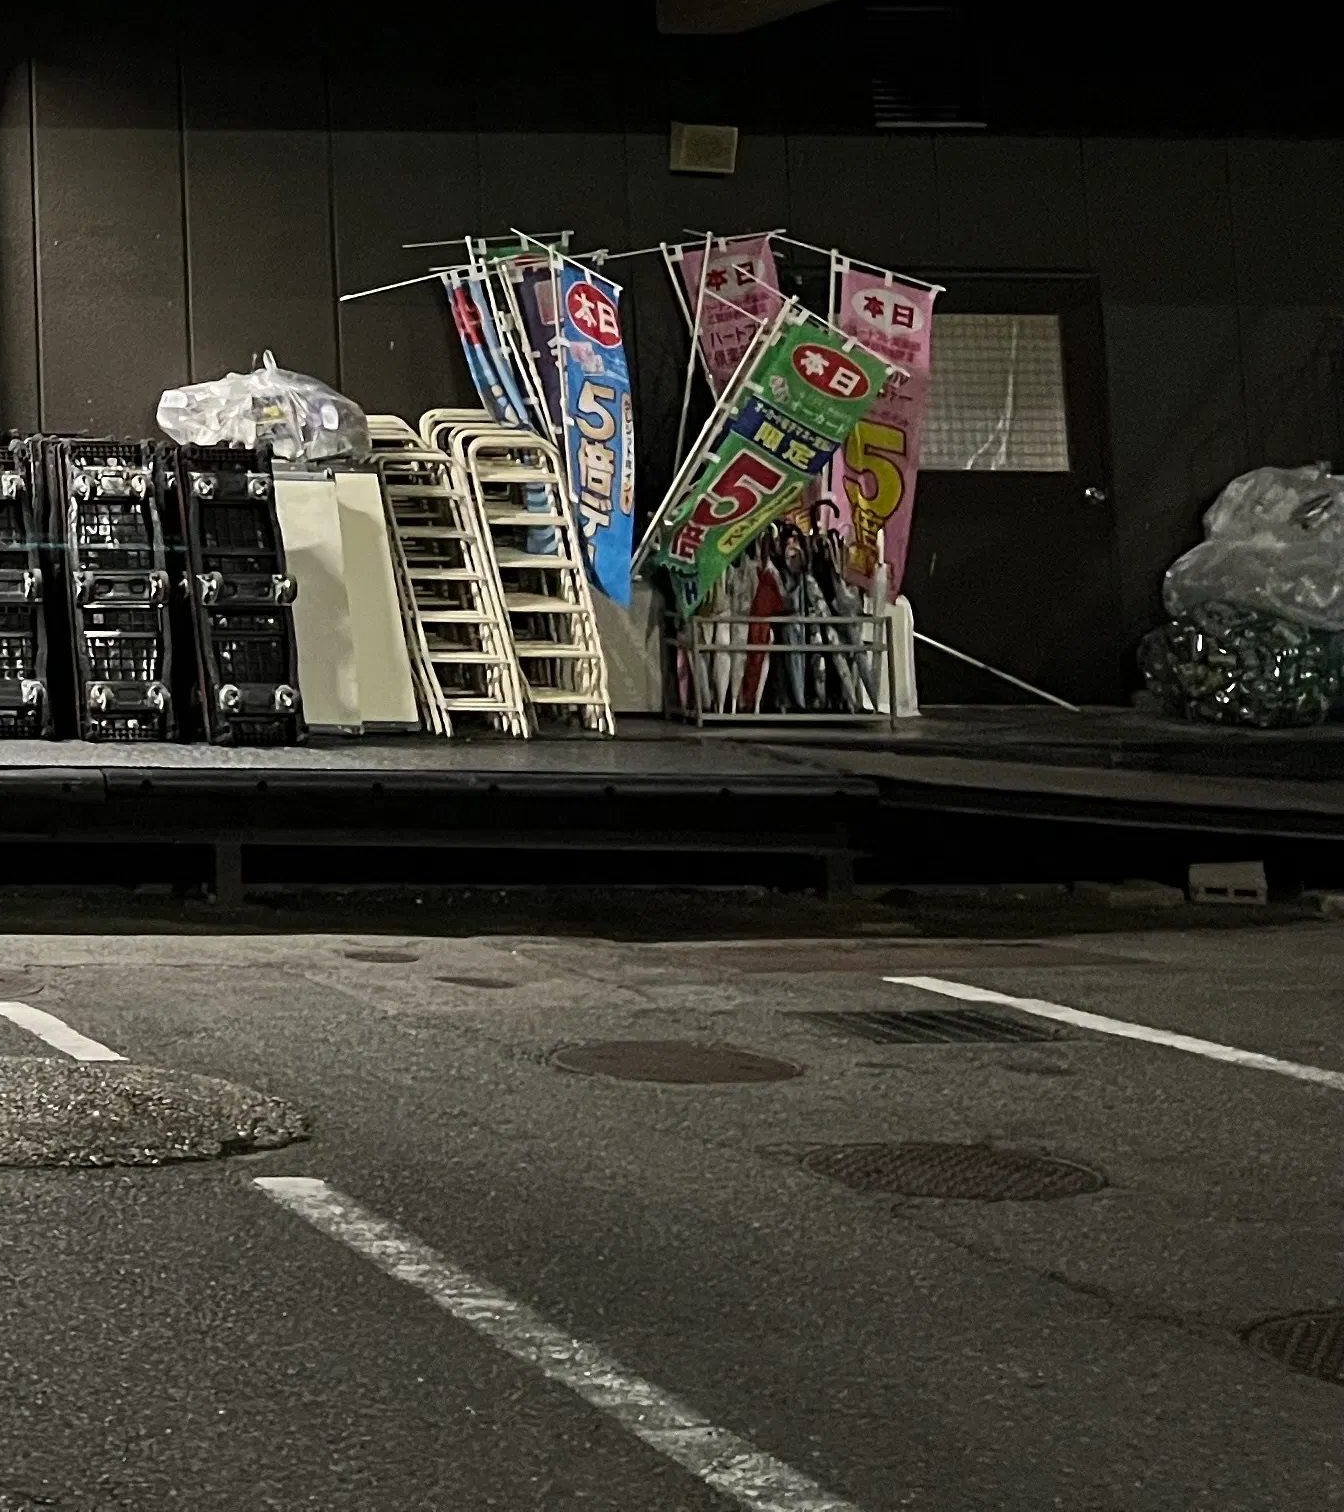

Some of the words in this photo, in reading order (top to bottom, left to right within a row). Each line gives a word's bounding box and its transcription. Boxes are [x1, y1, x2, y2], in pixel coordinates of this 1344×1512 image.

[705, 261, 756, 291] 本日
[573, 293, 620, 338] 本日
[863, 296, 914, 329] 本日
[800, 350, 861, 397] 本日
[753, 420, 817, 471] 限定
